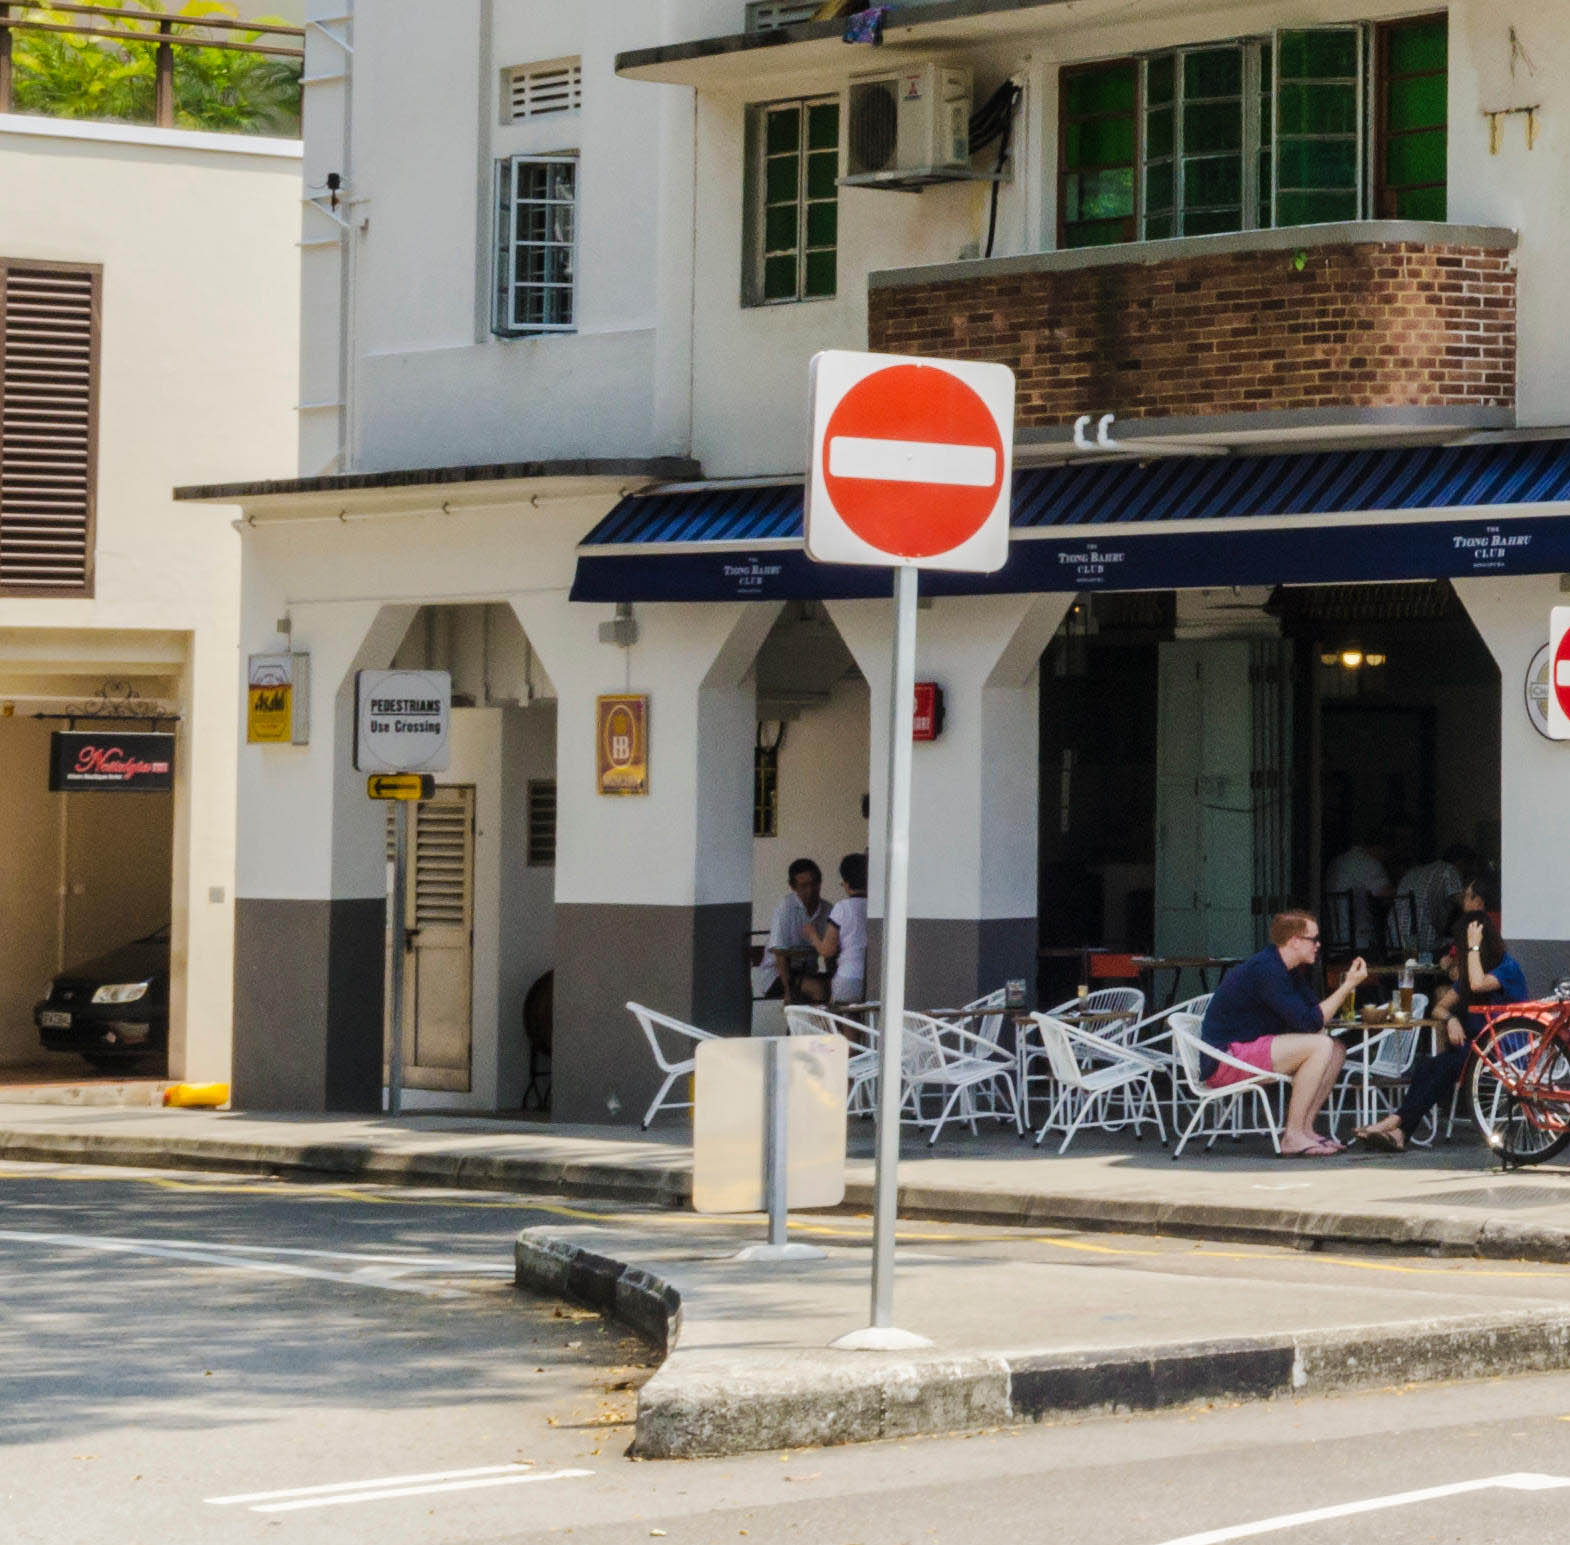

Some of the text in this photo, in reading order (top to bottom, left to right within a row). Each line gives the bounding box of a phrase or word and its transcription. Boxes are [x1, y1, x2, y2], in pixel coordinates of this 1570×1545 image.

[1453, 535, 1532, 548] TIONG BAHRU
[1058, 552, 1089, 564] TIONG
[1474, 548, 1506, 558] CLUB
[1077, 565, 1104, 574] CLUB
[371, 699, 441, 712] PEDESTRIANS
[371, 720, 441, 735] Use Crossing
